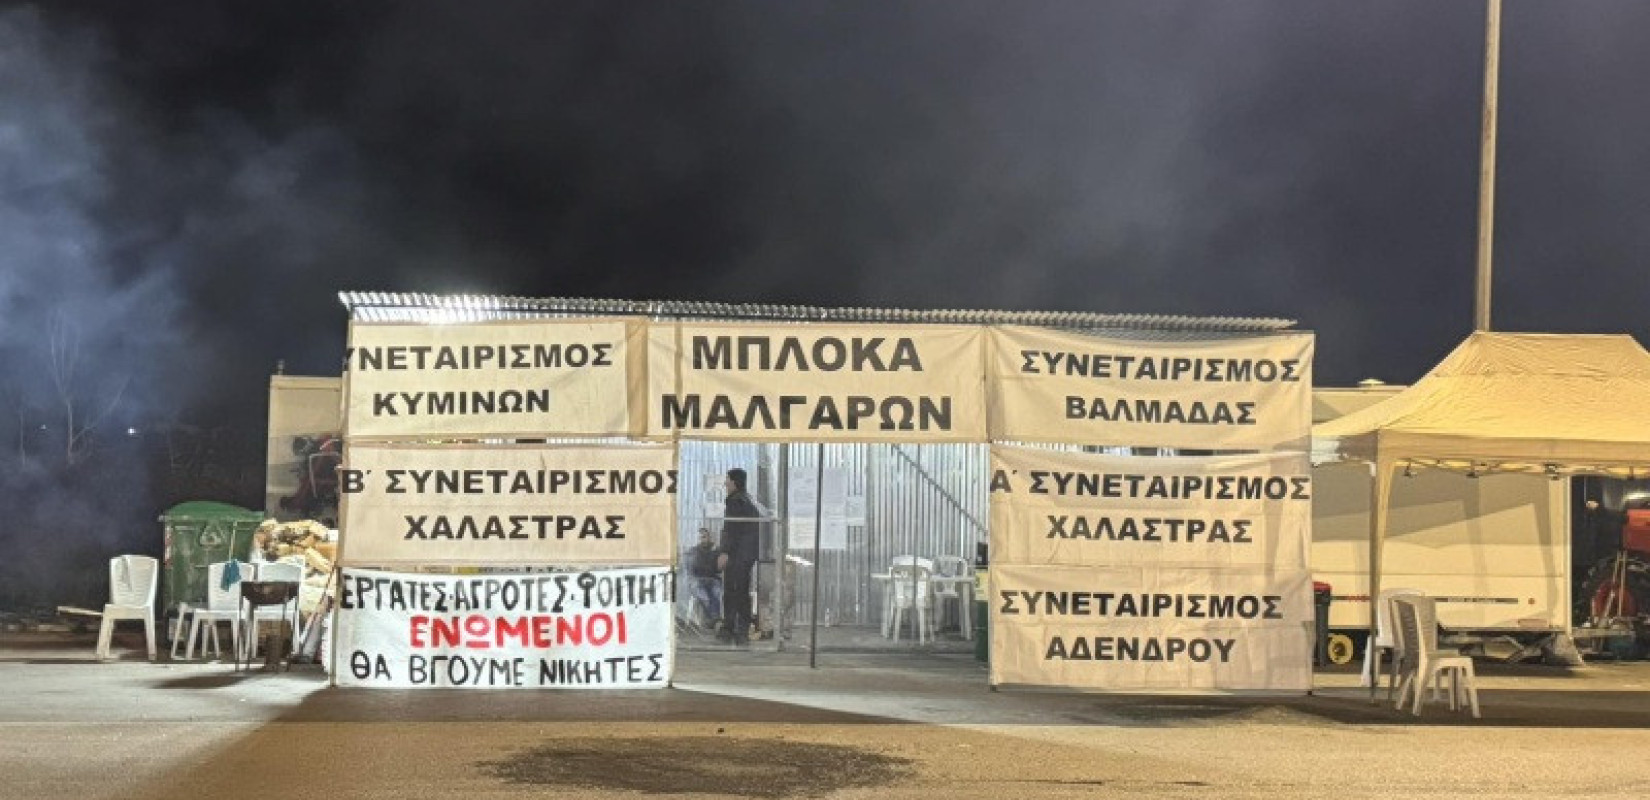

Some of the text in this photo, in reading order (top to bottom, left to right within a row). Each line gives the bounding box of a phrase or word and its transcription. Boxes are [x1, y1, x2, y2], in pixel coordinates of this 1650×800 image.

[693, 336, 922, 371] ΜΠΛΟΚΑ
[1020, 350, 1300, 382] ΣΥΝΕΤΑΙΡΙΣΜΟΣ
[373, 389, 549, 416] ΚΥΜΙΝΩΝ
[661, 394, 951, 431] ΜΑΛΓΑΡΩΝ
[1066, 396, 1256, 425] ΒΑΛΜΑΔΑΣ
[1030, 471, 1310, 500] ΣΥΝΕΤΑΙΡΙΣΜΟΣ
[404, 515, 626, 540] ΧΑΛΑΣΤΡΑΣ
[1047, 515, 1252, 543] ΧΑΛΑΣΤΡΑΣ
[1000, 591, 1283, 619] ΣΥΝΕΤΑΙΡΙΣΜΟΣ
[410, 611, 627, 649] ΕΝΩΜΕΝΟΙ
[1045, 636, 1235, 662] ΑΔΕΝΔΡΟΥ
[350, 650, 664, 685] ΘΑ ΒΓΟΥΜΕ ΝΙΚΗΤΕΣ
